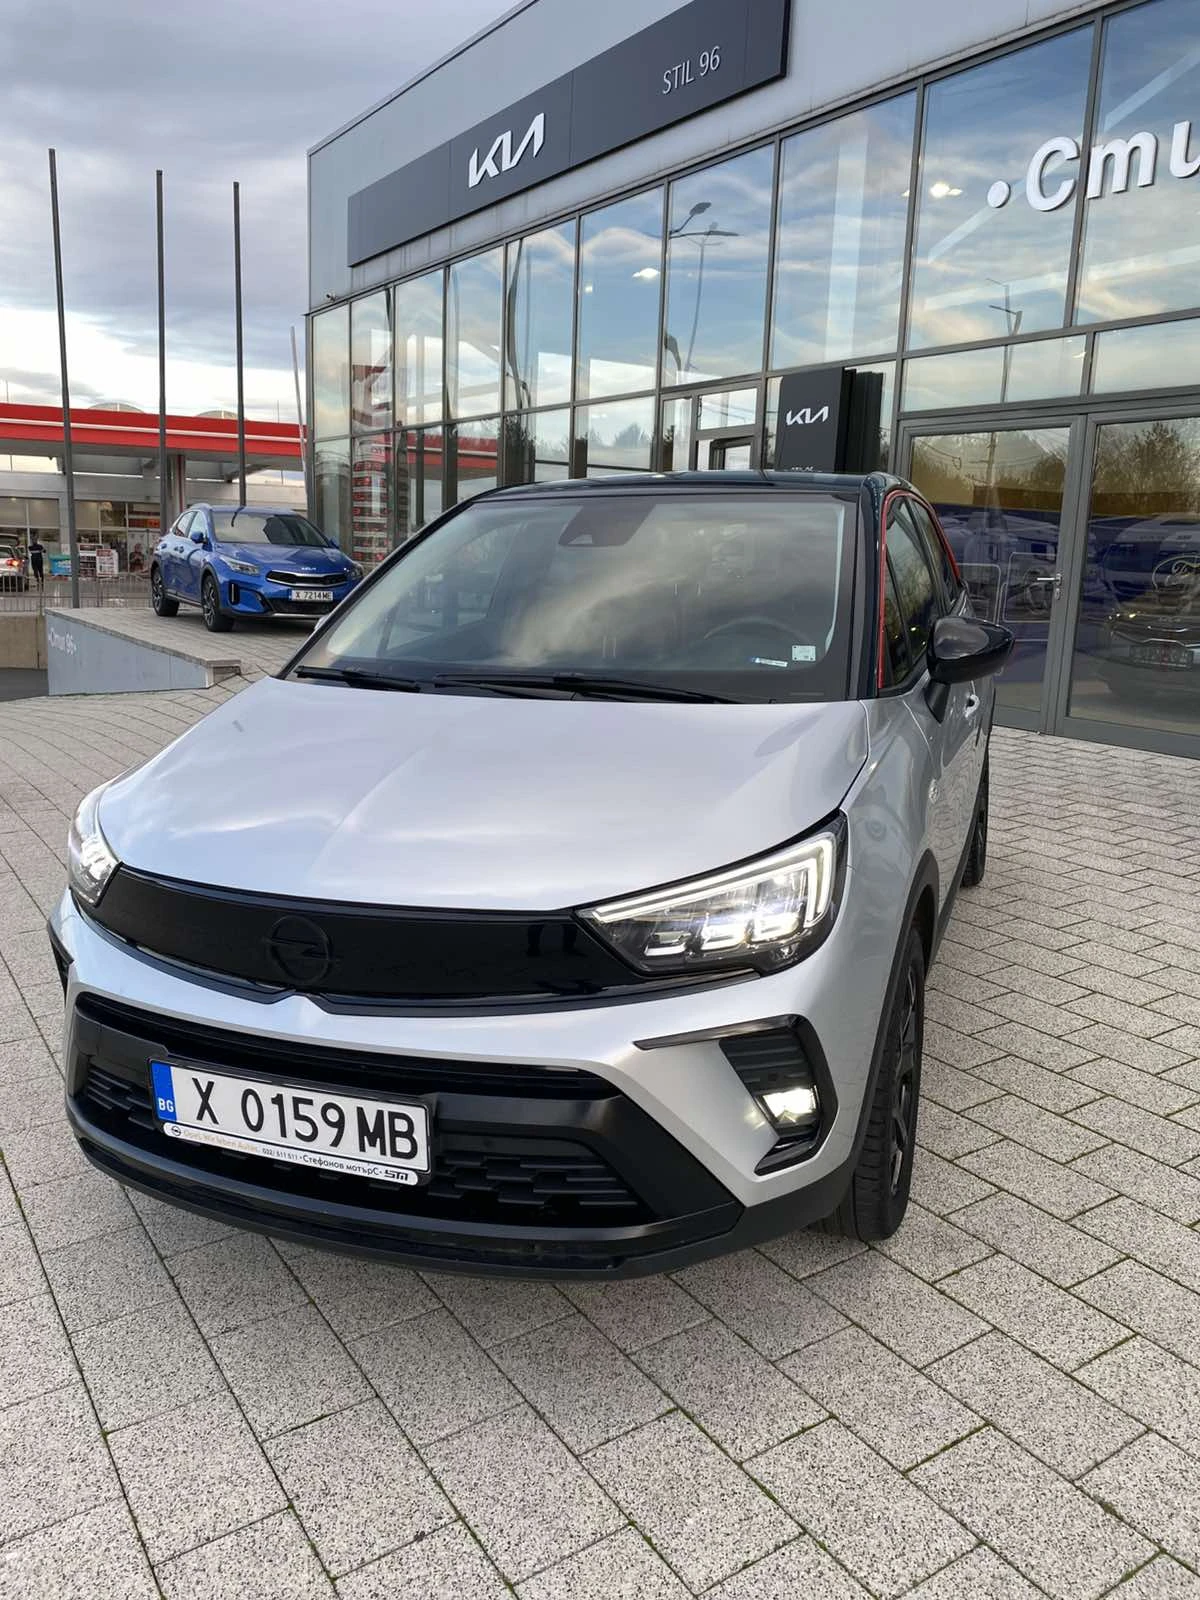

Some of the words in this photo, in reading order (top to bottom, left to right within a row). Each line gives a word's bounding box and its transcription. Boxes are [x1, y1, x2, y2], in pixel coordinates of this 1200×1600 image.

[662, 60, 695, 94] STIL
[700, 45, 720, 76] 96
[468, 112, 545, 188] KIA
[785, 406, 829, 426] KIA
[158, 1098, 175, 1113] BG
[192, 1077, 219, 1125] X
[241, 1088, 346, 1148] 0159
[356, 1106, 418, 1160] MB
